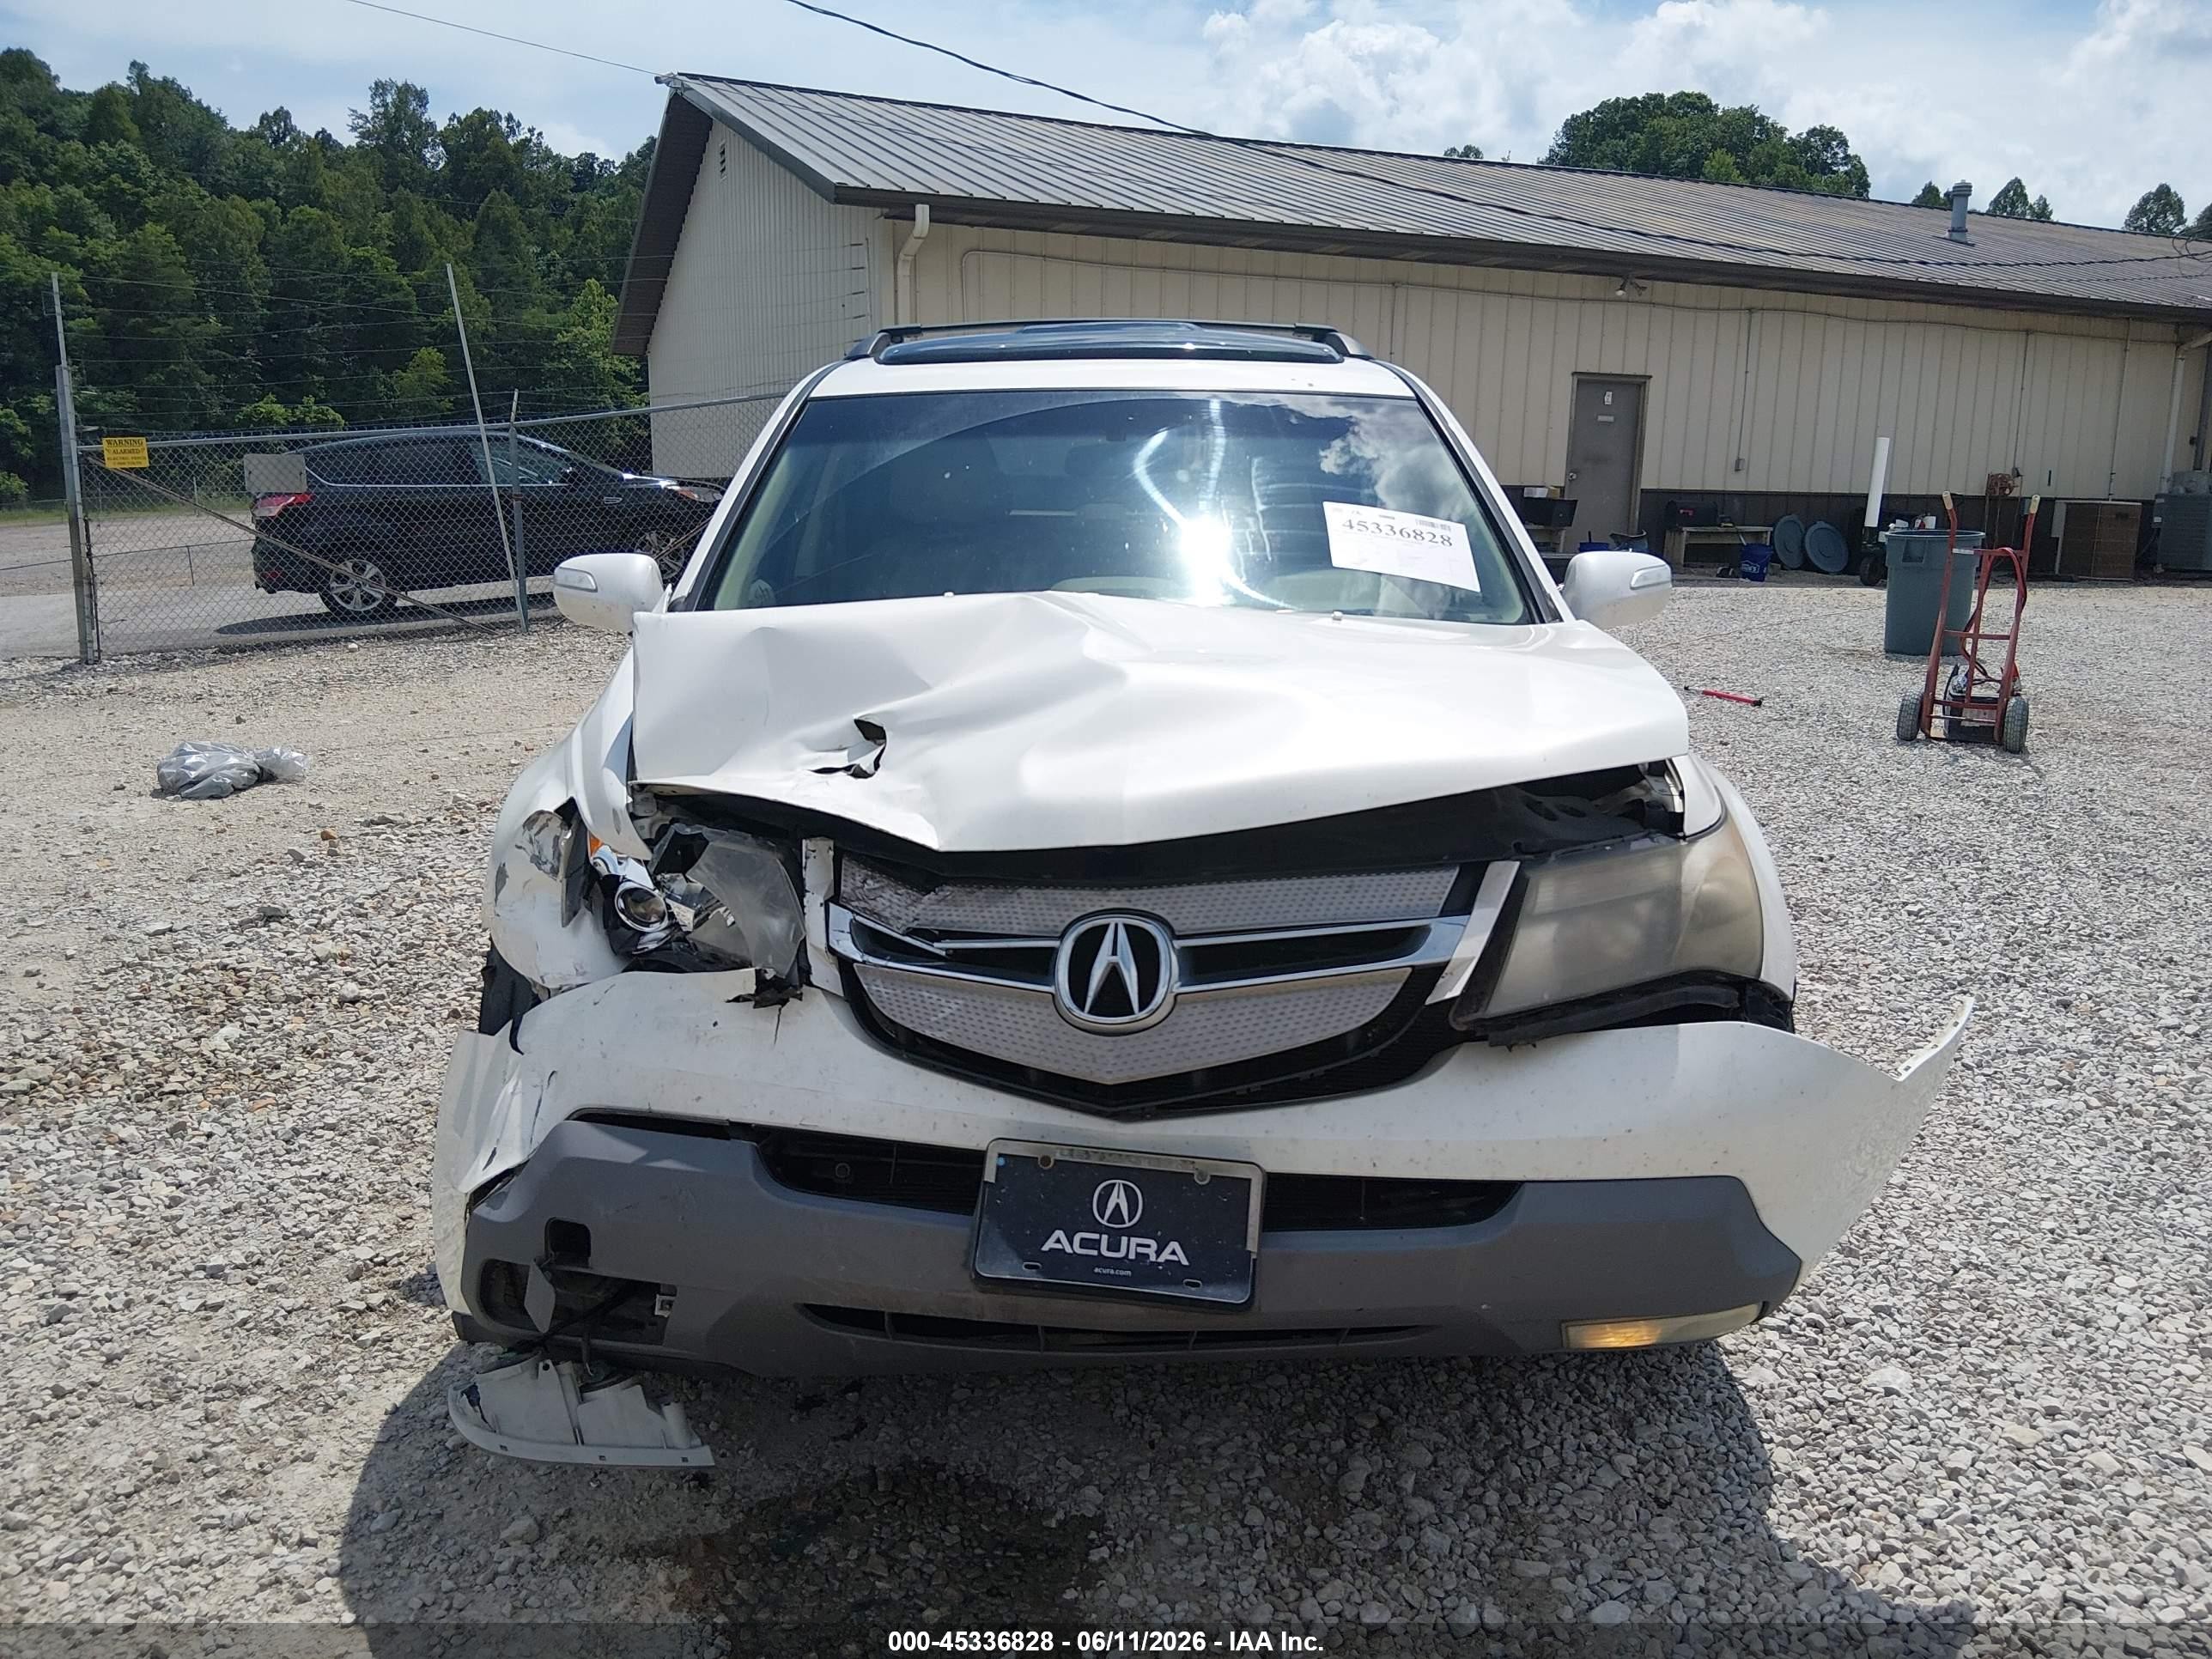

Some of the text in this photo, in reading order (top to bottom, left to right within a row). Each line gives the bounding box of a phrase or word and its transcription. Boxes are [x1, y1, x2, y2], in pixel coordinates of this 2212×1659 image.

[1341, 518, 1453, 547] 45336828
[1041, 1229, 1189, 1266] ACURA
[1093, 1267, 1132, 1277] acura.com
